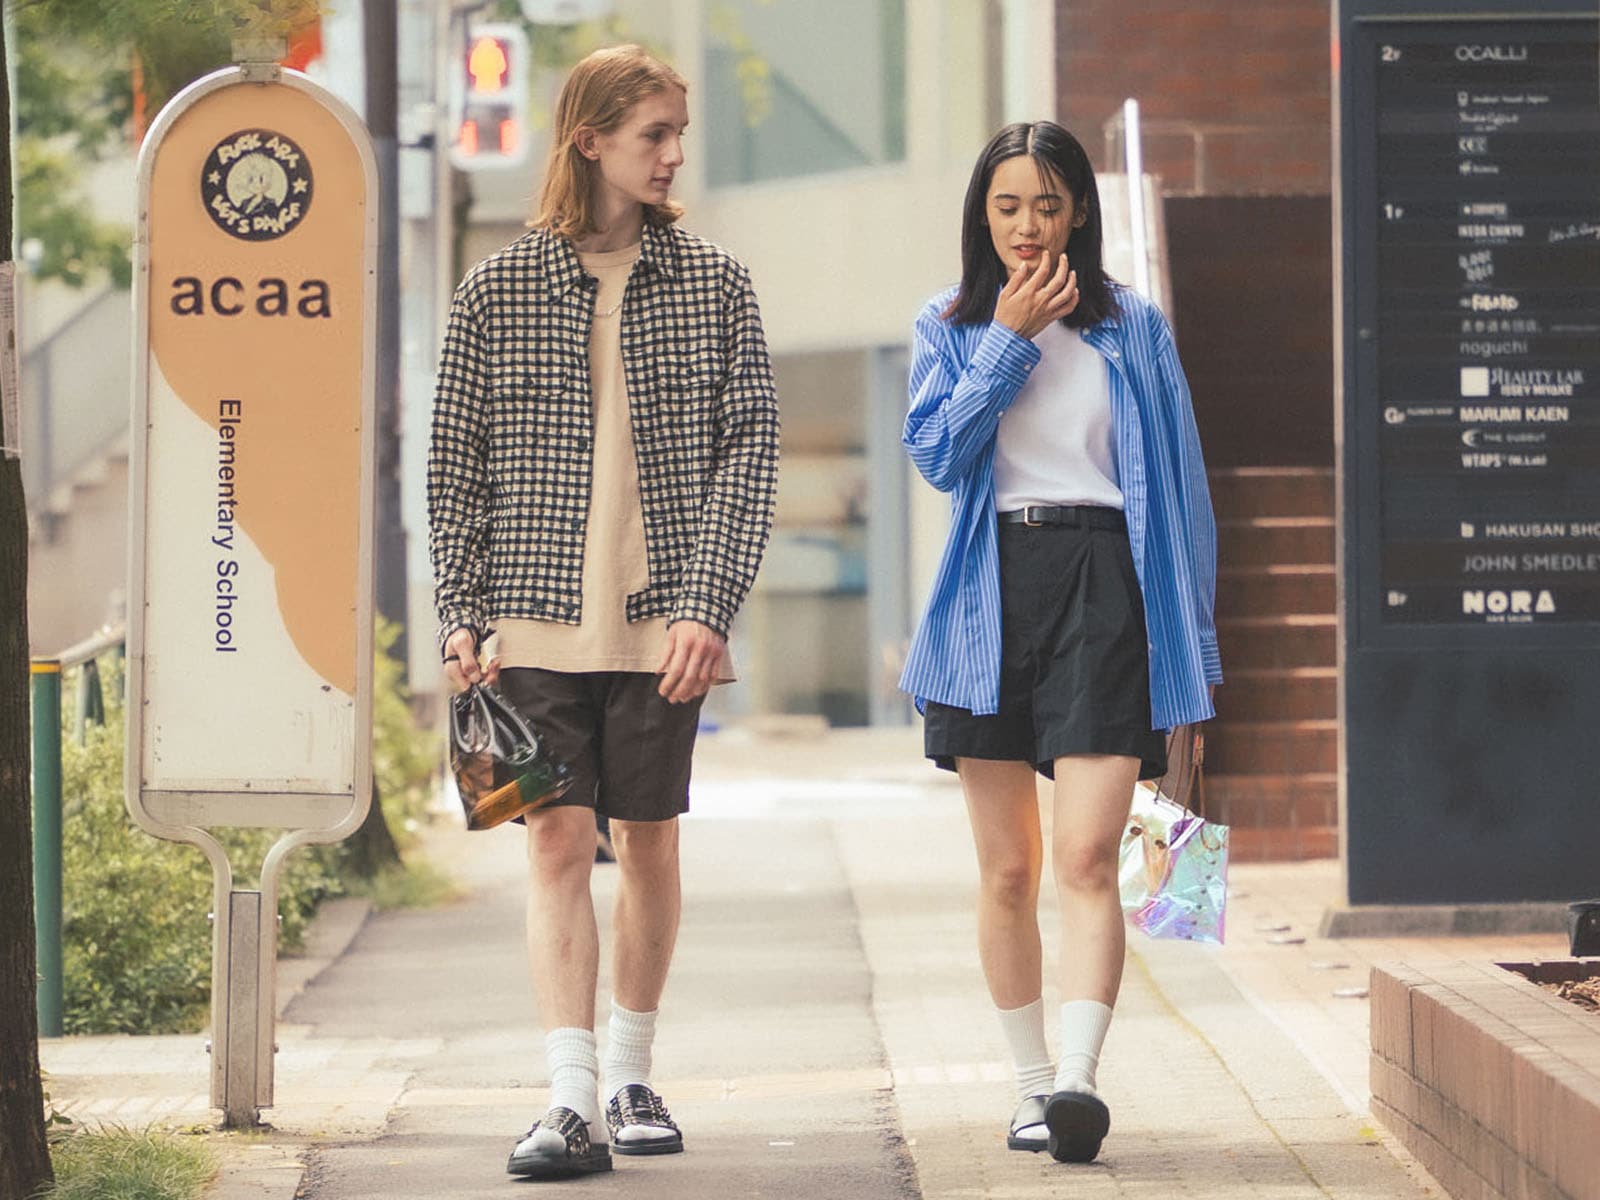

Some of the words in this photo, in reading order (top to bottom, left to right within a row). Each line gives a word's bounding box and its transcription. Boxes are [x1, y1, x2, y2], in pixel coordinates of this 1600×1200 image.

[211, 194, 250, 233] LET'S
[253, 202, 301, 233] DANCE
[171, 277, 331, 318] acaa
[1460, 341, 1527, 357] noguchi
[1460, 407, 1521, 422] MARUMI
[1526, 407, 1568, 421] KAEN
[212, 400, 241, 550] Elementary
[1486, 524, 1565, 536] HAKUSAN
[1465, 556, 1516, 571] JOHN
[216, 560, 238, 651] School
[1462, 590, 1556, 614] NORA
